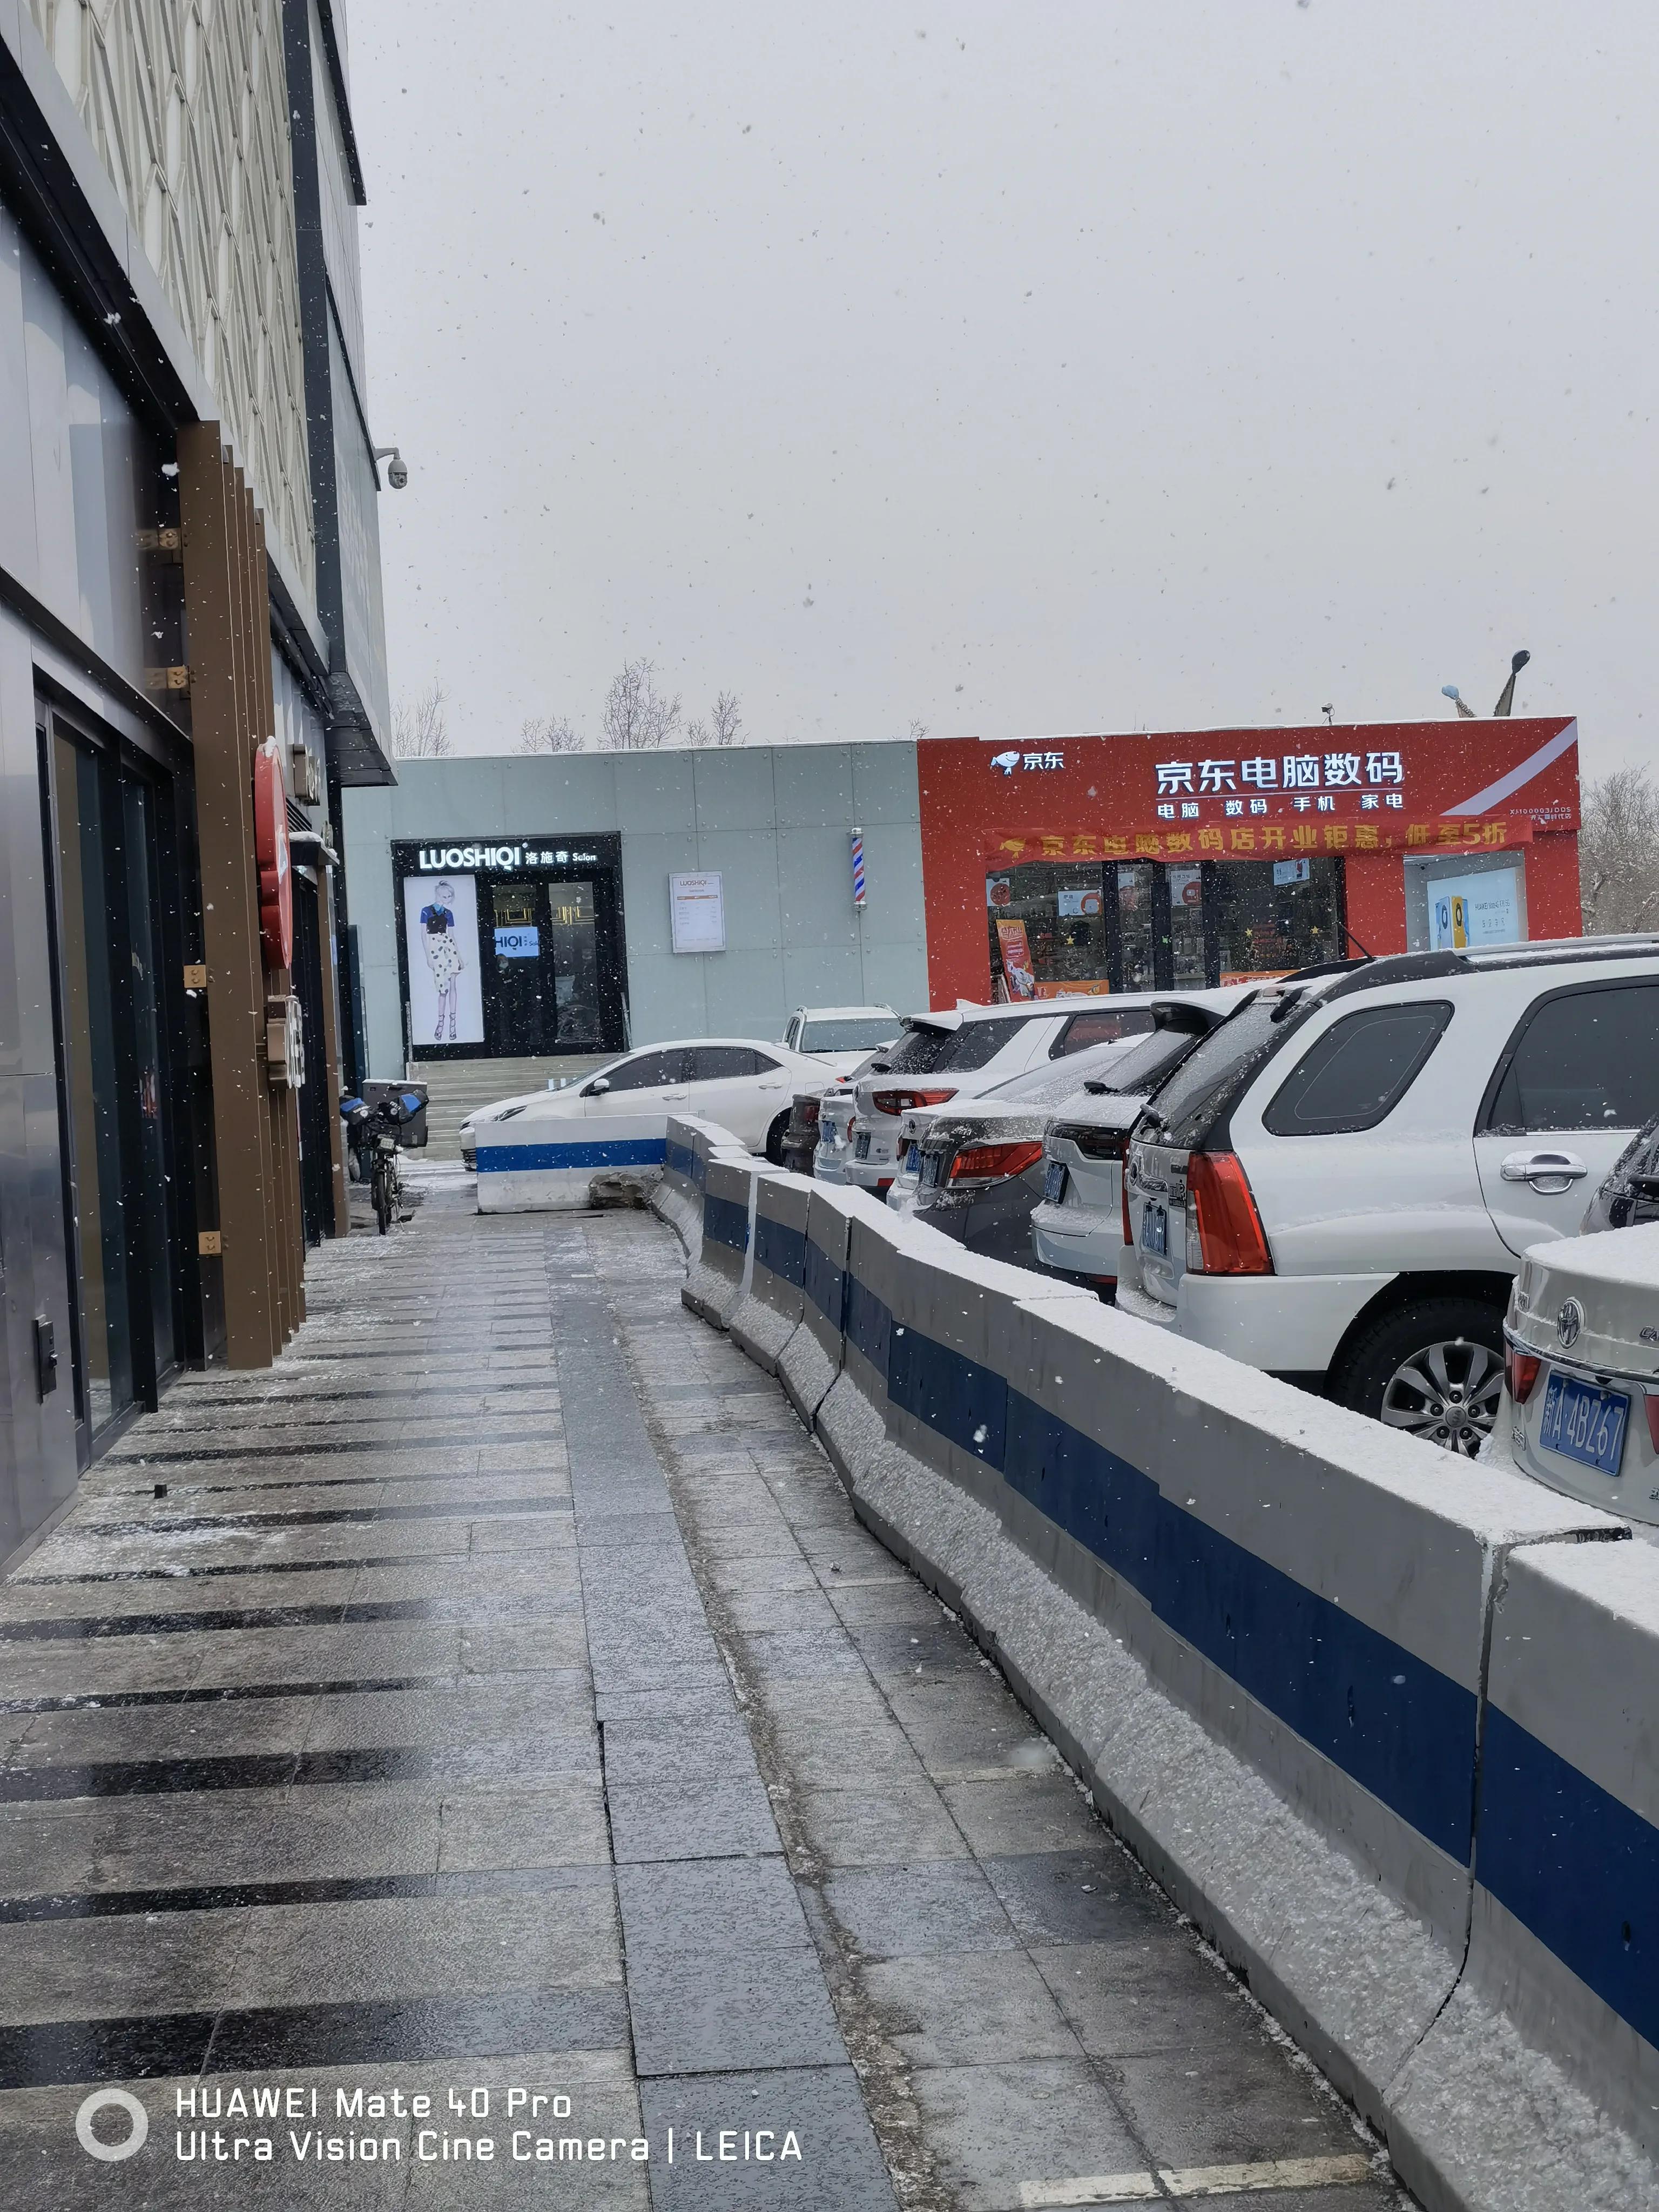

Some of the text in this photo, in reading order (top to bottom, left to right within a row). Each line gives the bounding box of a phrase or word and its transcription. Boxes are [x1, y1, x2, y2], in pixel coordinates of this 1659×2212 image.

[1022, 751, 1064, 770] 京东
[1155, 752, 1404, 794] 京东电脑数码
[1157, 793, 1404, 819] 电脑 数码 手机 家电
[419, 847, 596, 871] LUOSHIQI 洛施奇 Salon
[1639, 1326, 1659, 1342] CA
